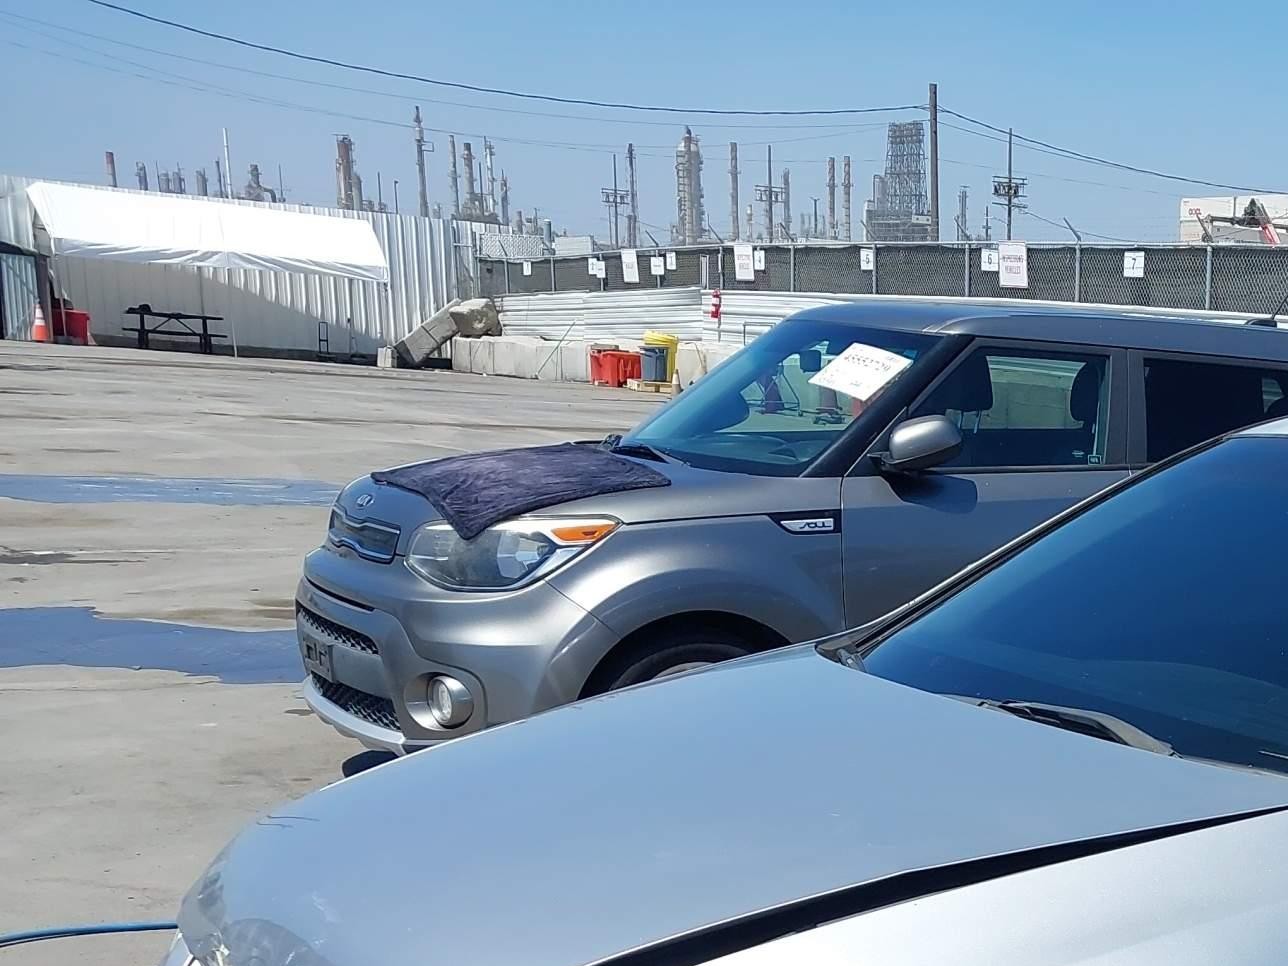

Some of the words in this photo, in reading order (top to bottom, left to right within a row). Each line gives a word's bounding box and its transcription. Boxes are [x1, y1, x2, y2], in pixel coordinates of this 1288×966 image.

[865, 253, 870, 265] 5
[987, 253, 993, 265] 6
[1131, 257, 1137, 270] 7
